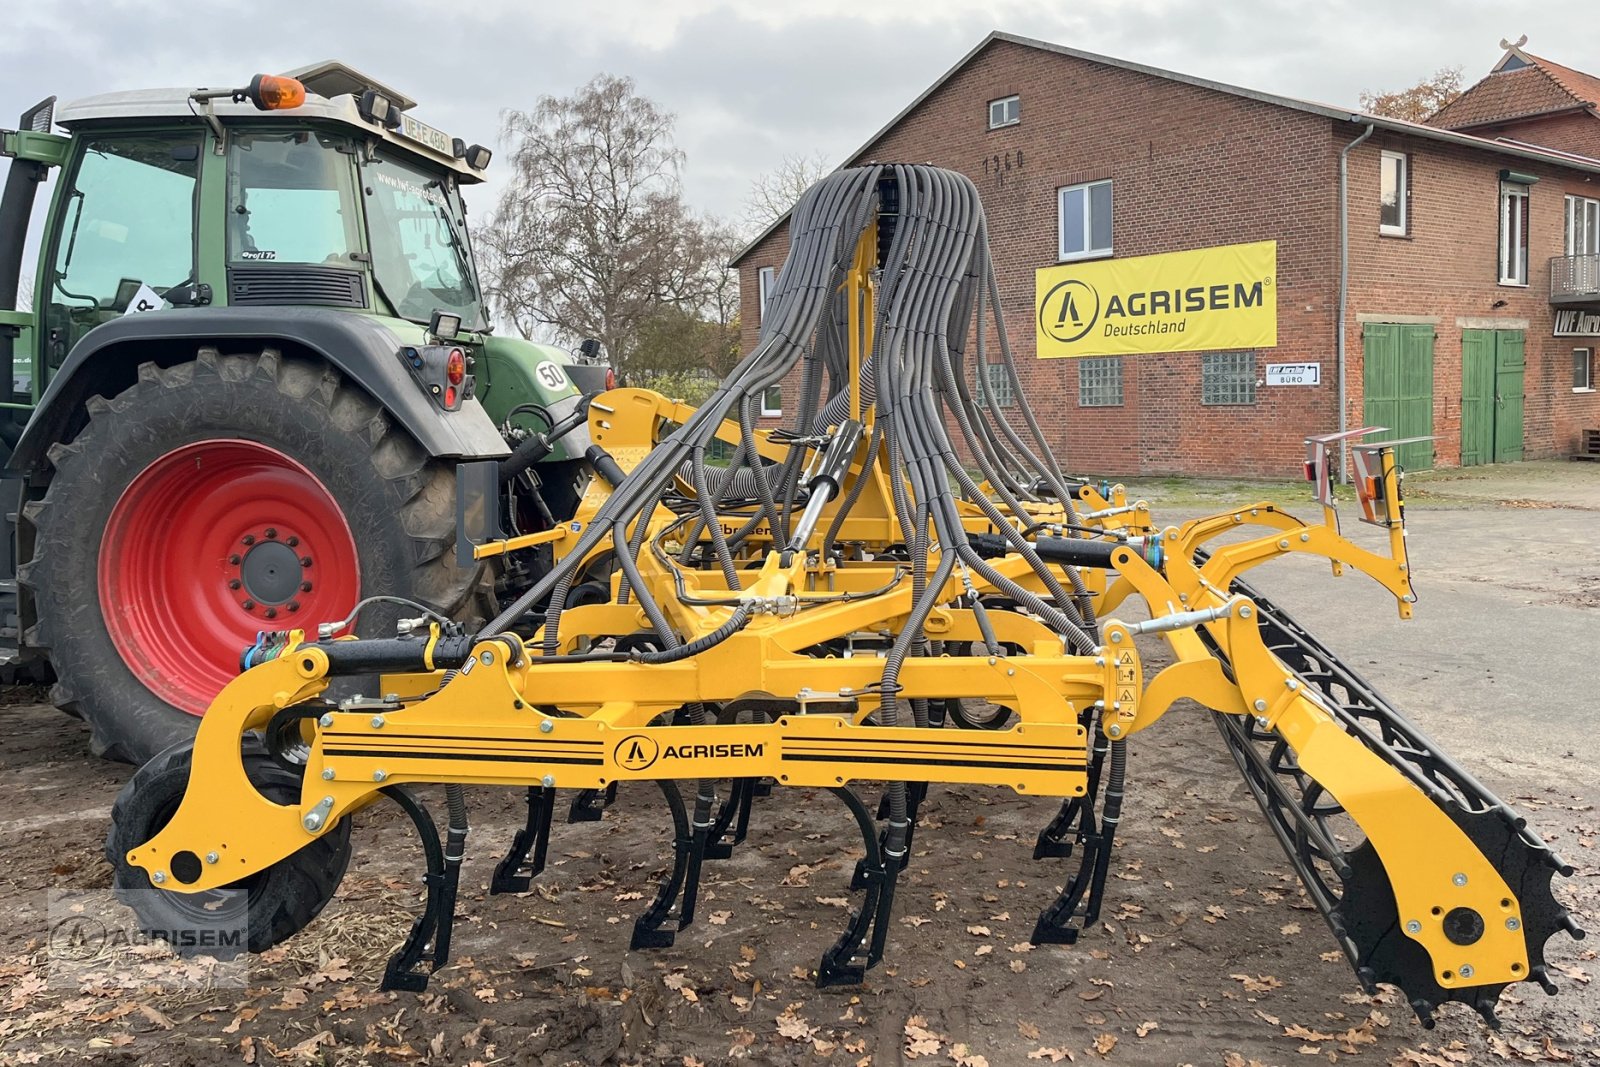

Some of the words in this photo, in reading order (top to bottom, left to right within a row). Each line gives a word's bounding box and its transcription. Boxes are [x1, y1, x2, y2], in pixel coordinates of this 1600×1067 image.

[982, 149, 1024, 174] 1960
[1104, 319, 1186, 337] Deutschland
[1576, 311, 1600, 333] Agro
[538, 364, 565, 388] 50
[1280, 375, 1303, 384] BÜRO
